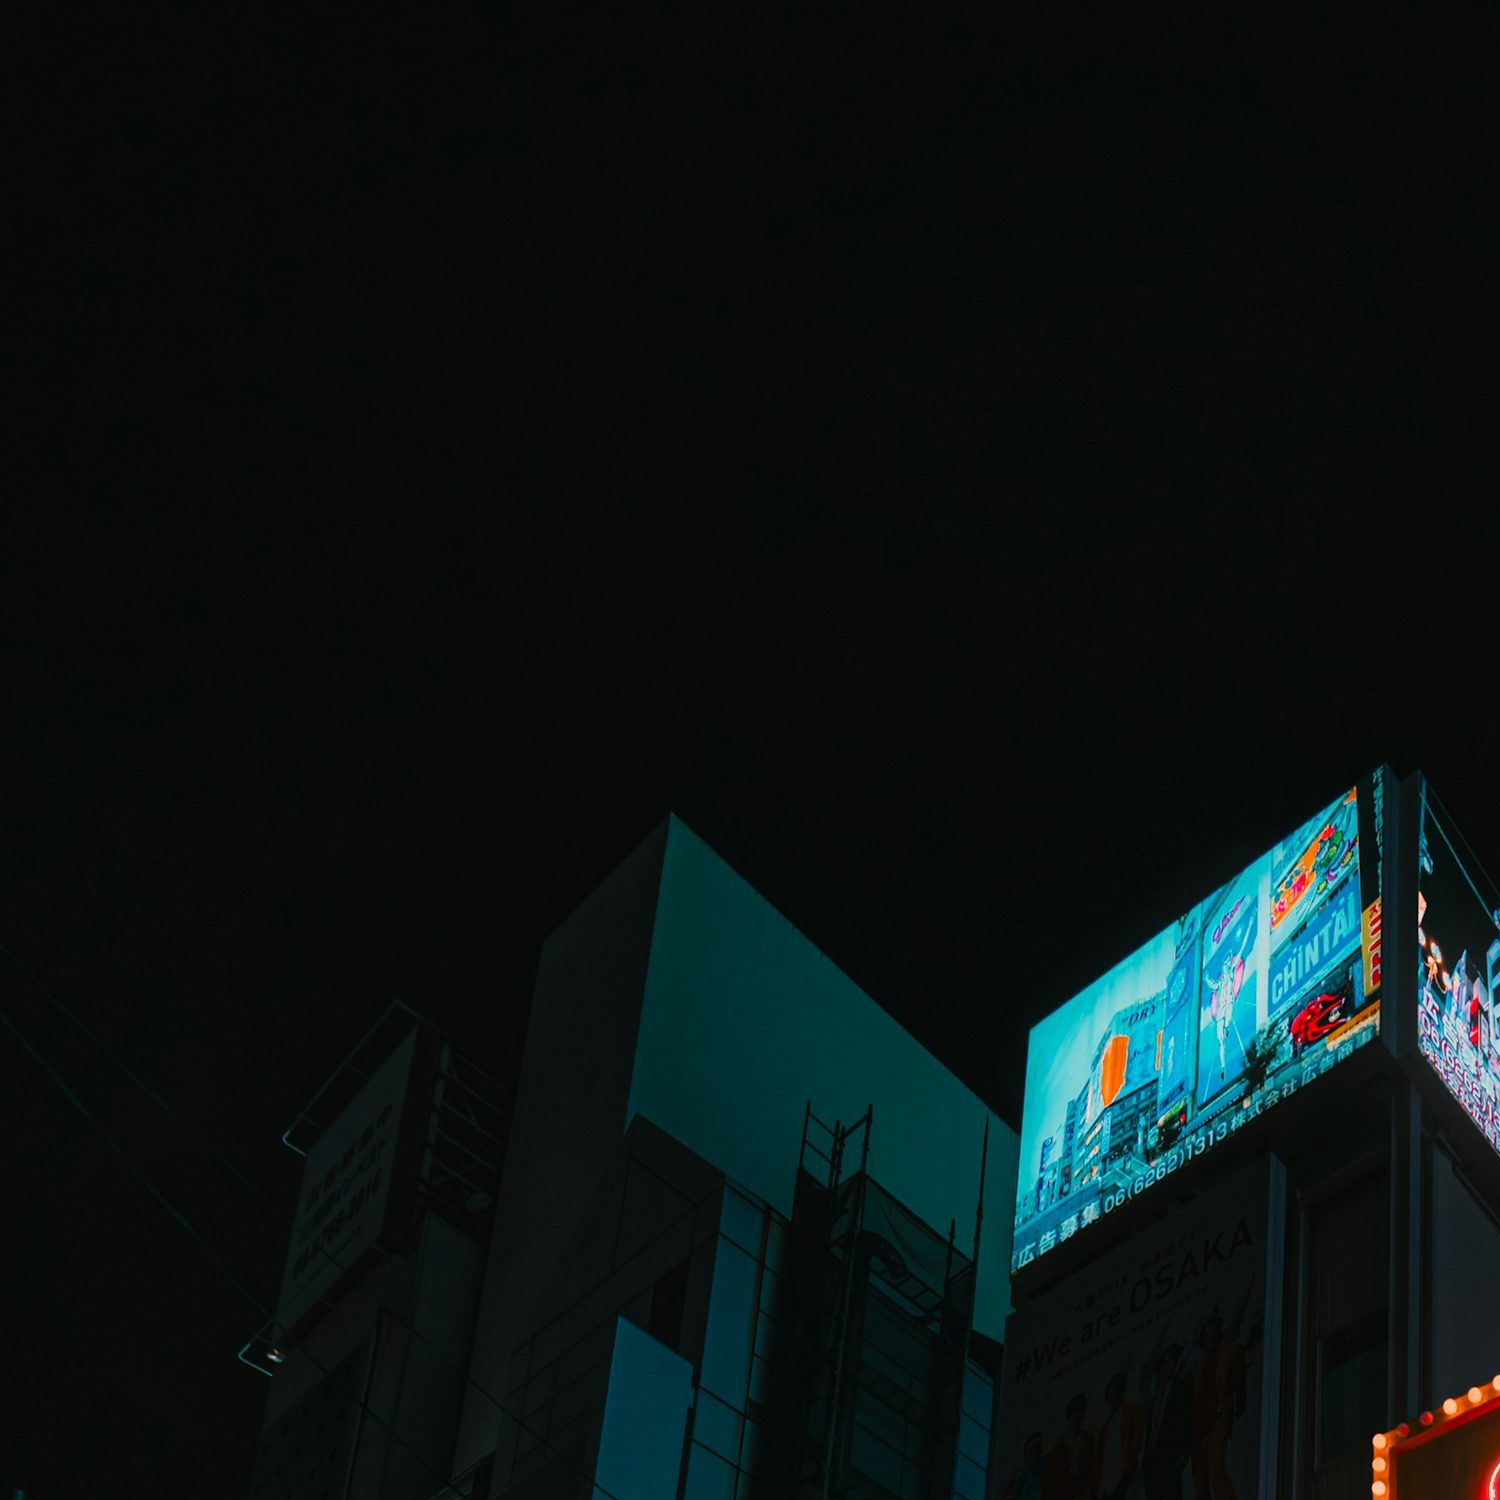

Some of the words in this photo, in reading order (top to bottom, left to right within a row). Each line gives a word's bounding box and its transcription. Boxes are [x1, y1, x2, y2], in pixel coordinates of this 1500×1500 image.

[1017, 1197, 1101, 1268] 広告募集
[1104, 1121, 1227, 1215] 06(6262)1313
[1013, 1332, 1071, 1385] #We
[1081, 1304, 1122, 1346] are
[1129, 1217, 1255, 1314] OSAKA
